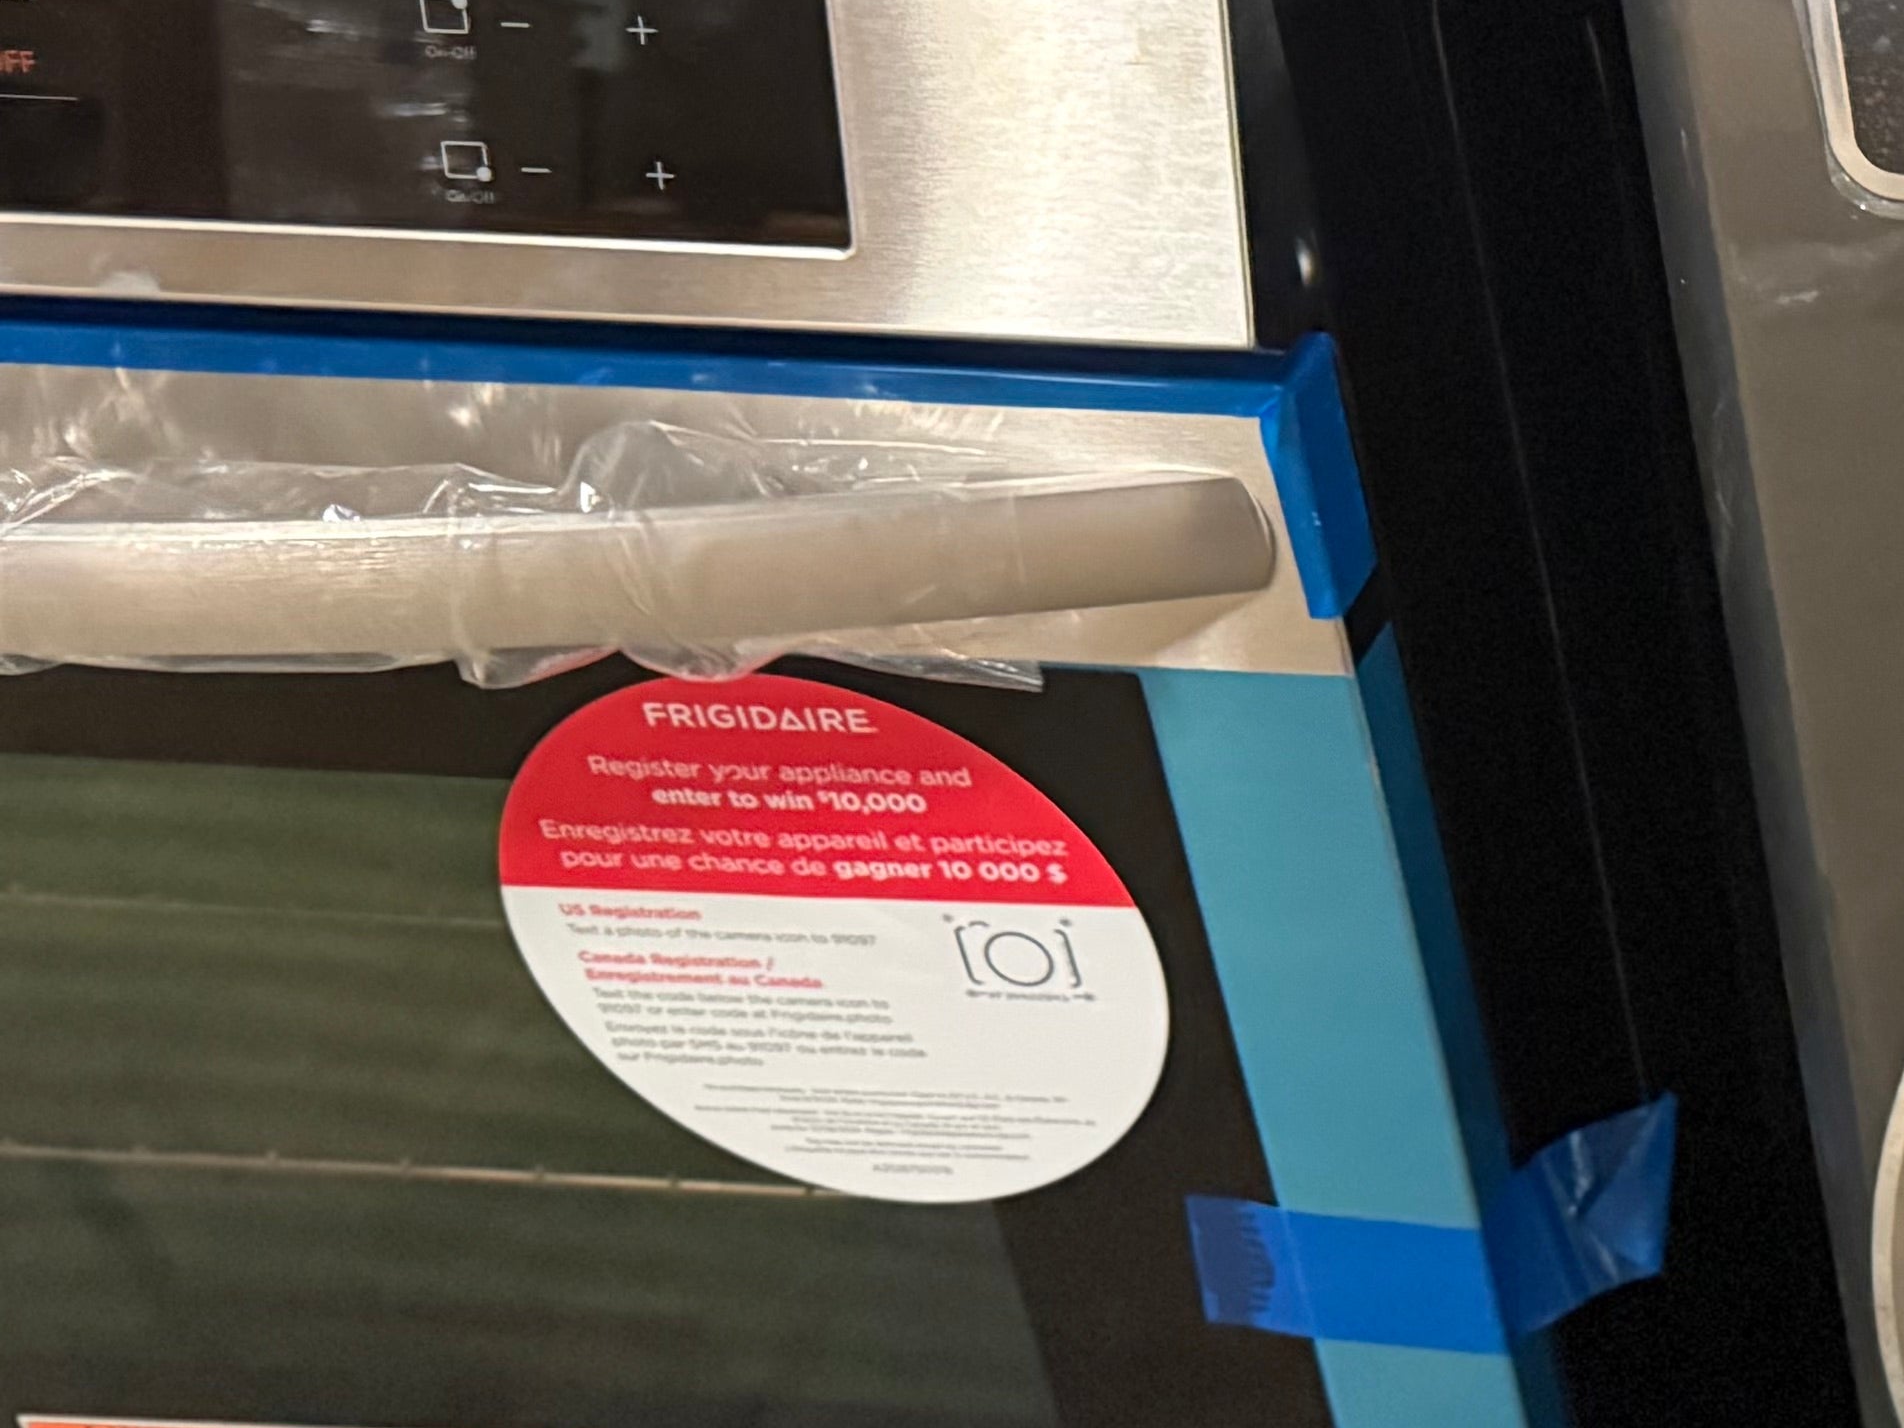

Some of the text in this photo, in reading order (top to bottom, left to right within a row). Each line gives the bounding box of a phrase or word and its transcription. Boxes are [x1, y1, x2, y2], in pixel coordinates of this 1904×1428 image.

[641, 702, 879, 733] FRIGIDAIRE
[587, 754, 973, 788] Register your appliance and
[652, 788, 928, 815] enter to win $10,000
[538, 818, 1068, 858] Enregistrez votre appareil et participez
[560, 850, 1069, 886] pour une chance de gagner 10 000 $
[558, 902, 702, 921] US Registration
[577, 949, 647, 966] Canada
[650, 951, 761, 970] Registration
[585, 967, 824, 990] Enregistrement au Canada
